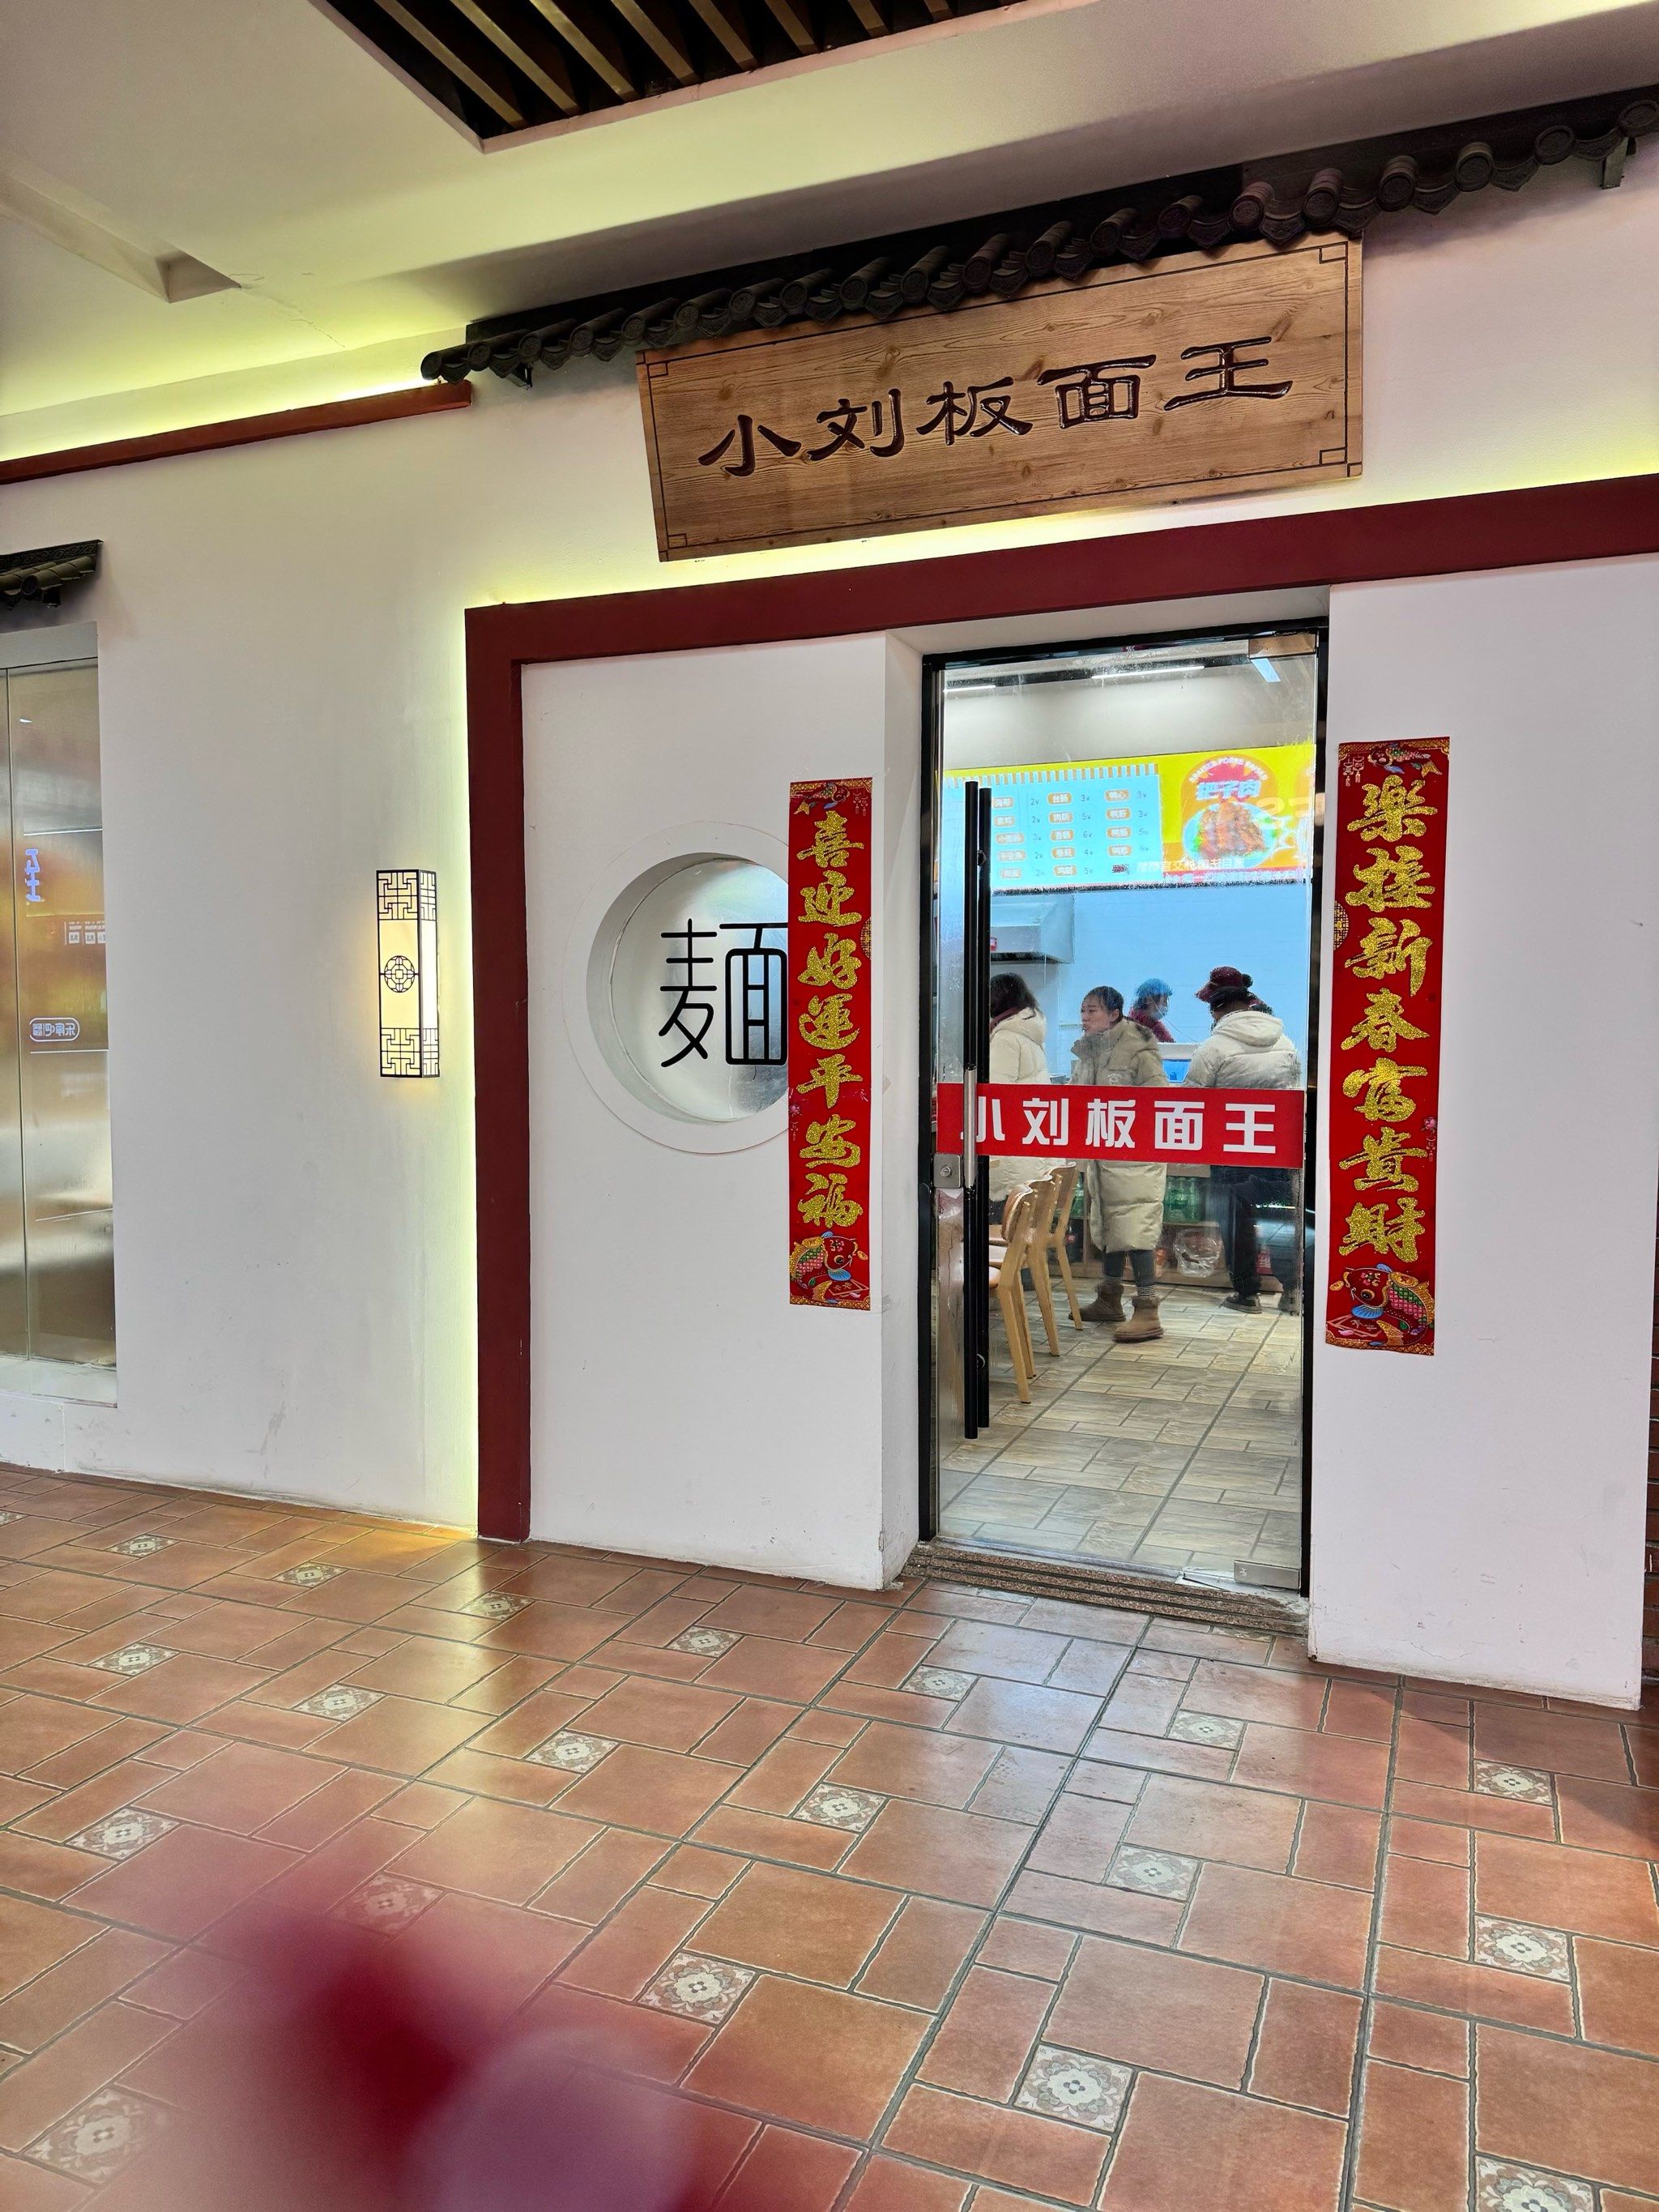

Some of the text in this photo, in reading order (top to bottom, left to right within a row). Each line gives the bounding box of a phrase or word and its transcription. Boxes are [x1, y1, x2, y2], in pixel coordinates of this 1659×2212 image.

[698, 335, 1293, 477] 小刘板面王
[796, 810, 864, 1228] 喜迎好運平安福
[961, 1097, 1277, 1154] 小刘板面王
[1337, 774, 1438, 1262] 樂接新春富貴財
